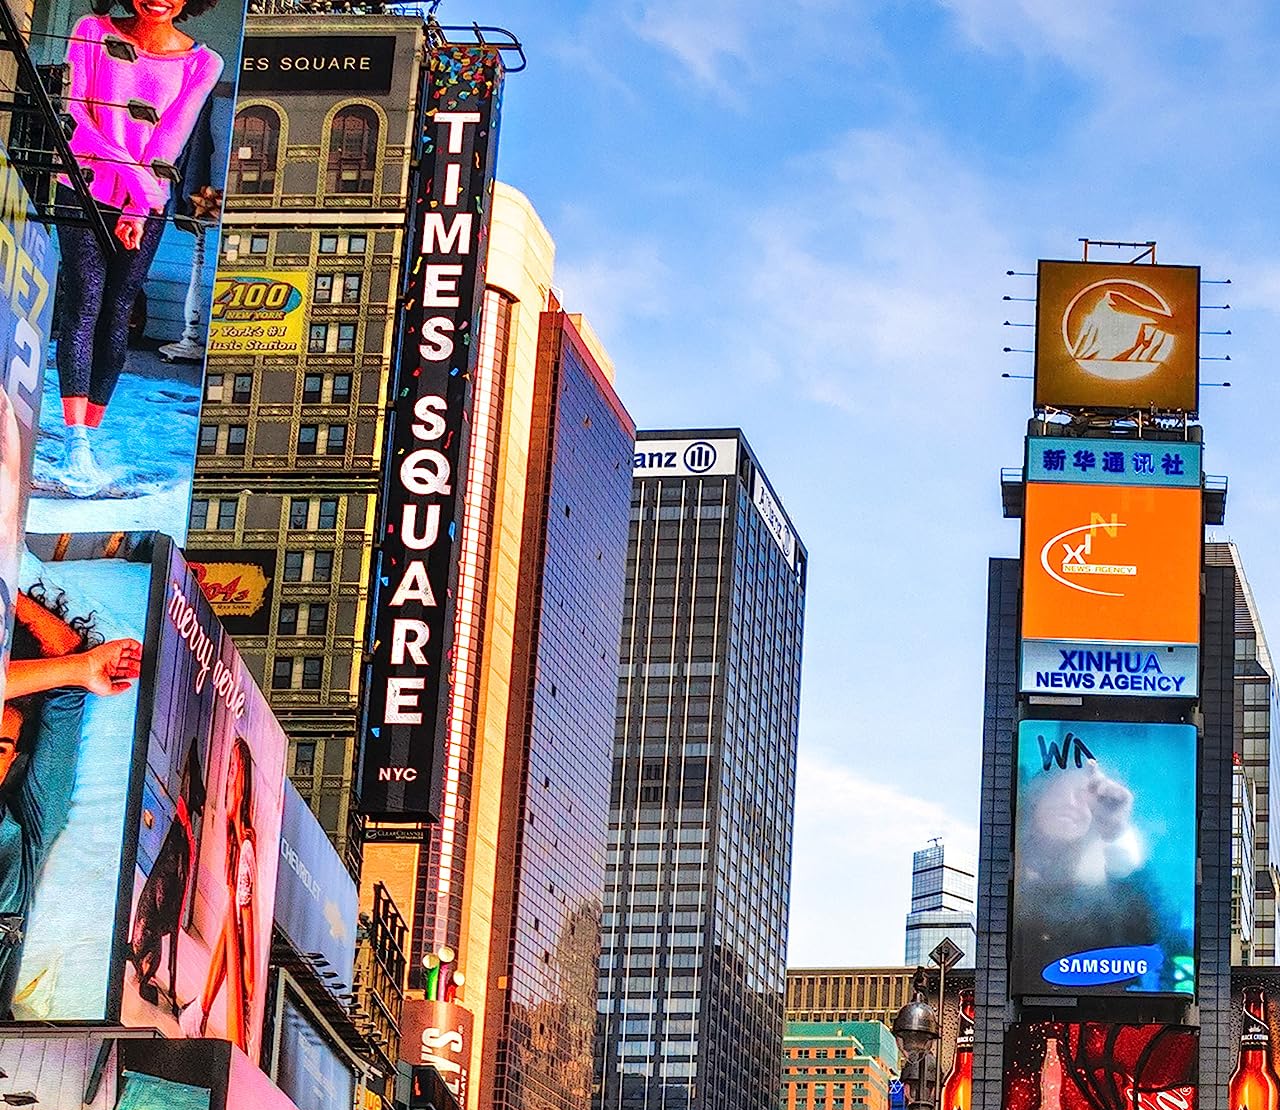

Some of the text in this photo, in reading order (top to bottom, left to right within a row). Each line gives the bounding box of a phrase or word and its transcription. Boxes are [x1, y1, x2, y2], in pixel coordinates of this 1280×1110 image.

[280, 55, 371, 71] SQUARE
[419, 111, 480, 361] TIMES
[252, 311, 284, 319] YORK
[222, 325, 287, 337] York's #1
[245, 339, 298, 351] Station
[633, 451, 677, 468] anz
[1043, 450, 1184, 475] 新华通讯社
[384, 395, 452, 724] SQUARE
[1064, 565, 1133, 574] NEWS AGENCY
[1059, 650, 1163, 674] XINHUA
[1036, 672, 1186, 692] NEWS AGENCY
[378, 767, 417, 781] NYC
[1059, 958, 1148, 975] SAMSUNG
